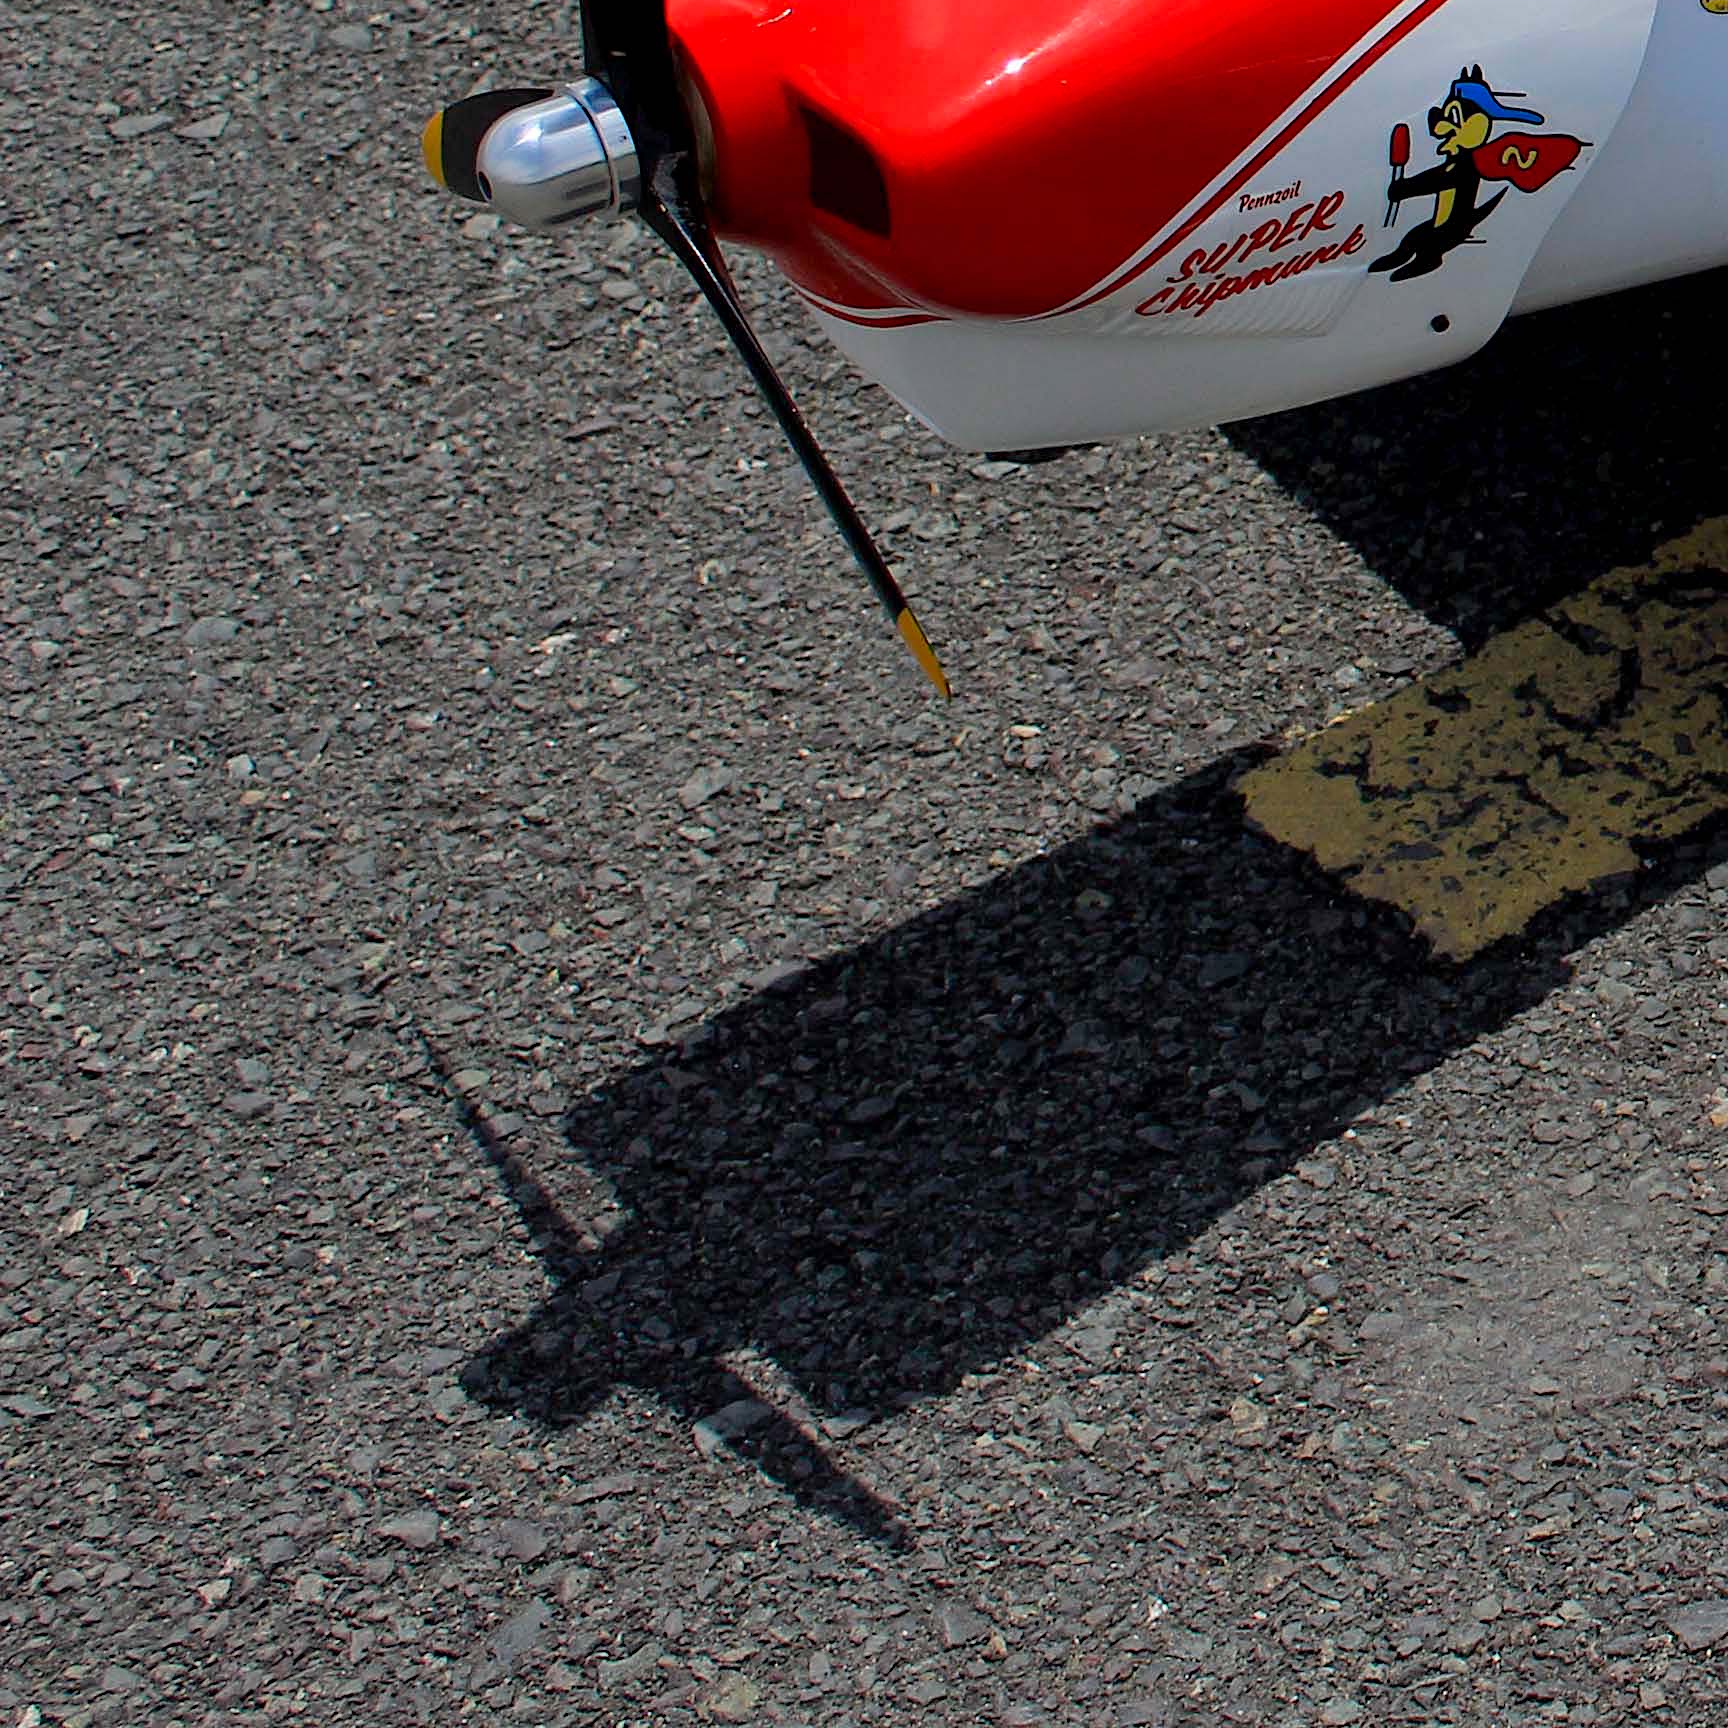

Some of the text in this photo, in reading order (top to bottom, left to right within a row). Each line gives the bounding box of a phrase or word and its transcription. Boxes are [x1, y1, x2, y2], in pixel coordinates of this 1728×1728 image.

[1166, 190, 1345, 284] SUPER
[1238, 179, 1302, 213] Pennzoil
[1134, 223, 1367, 318] Chipmunk
